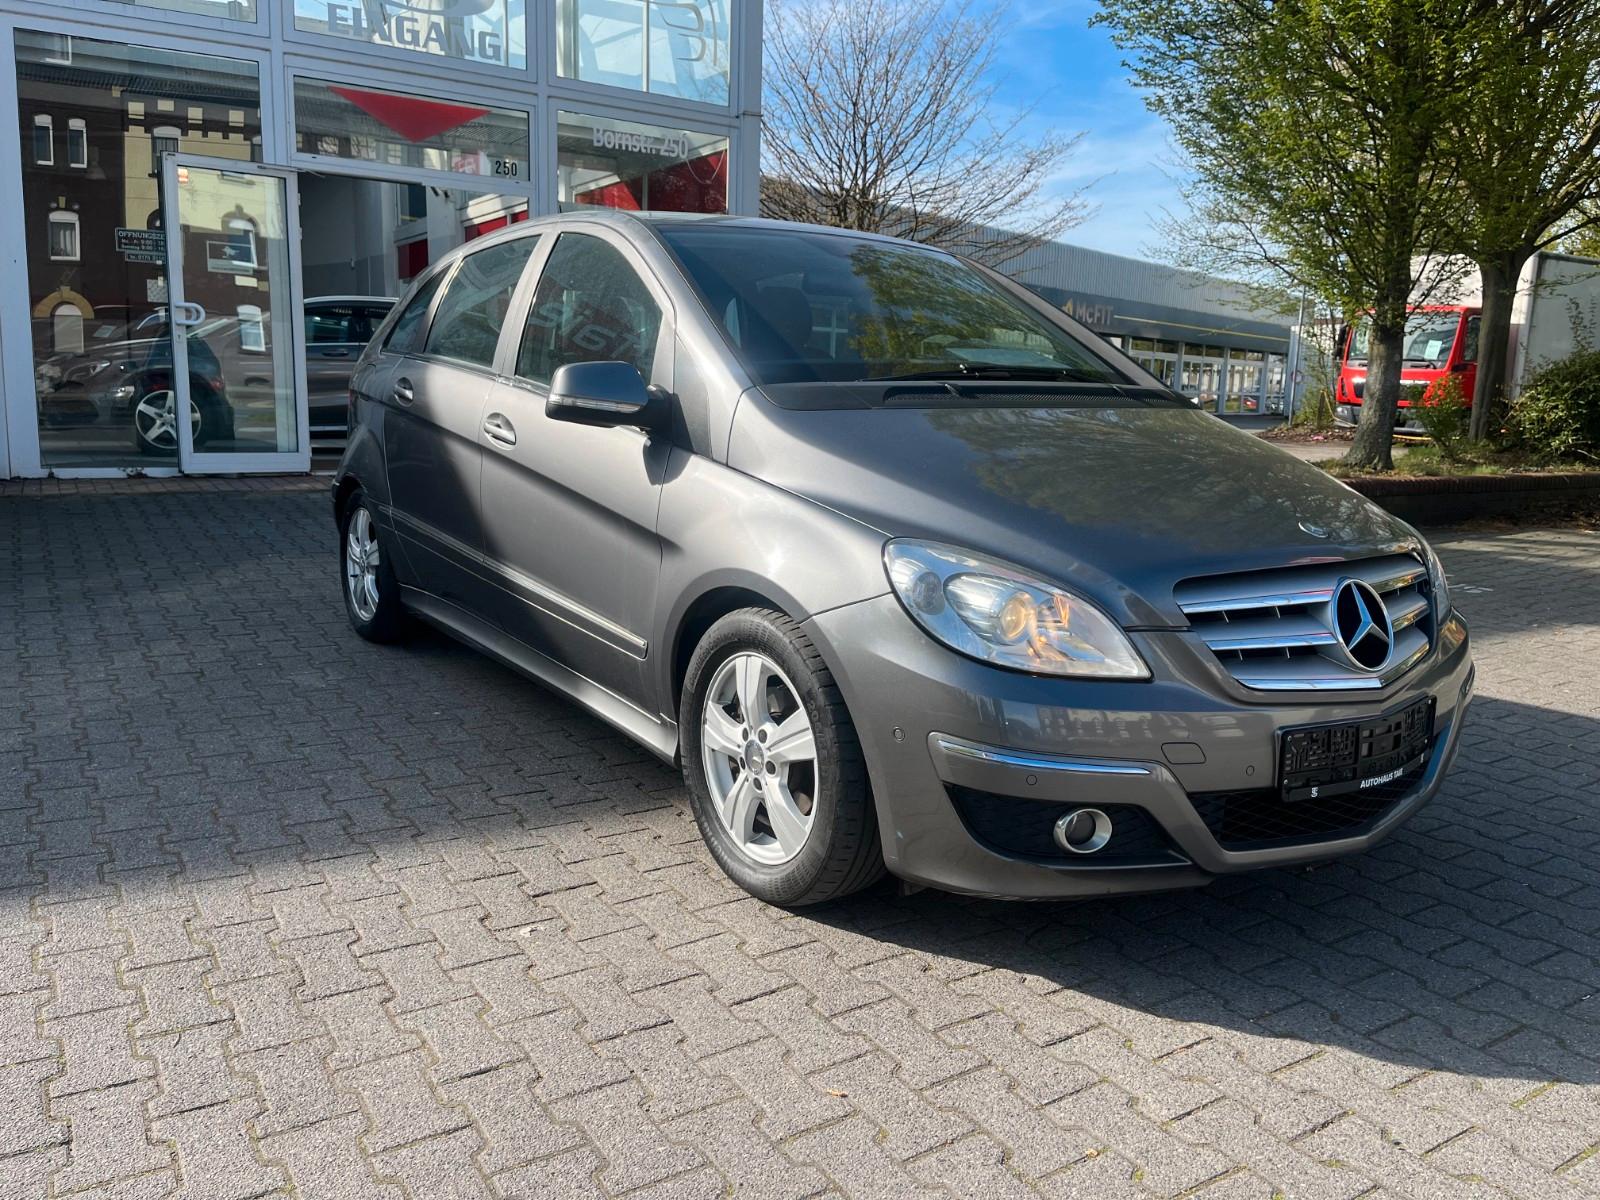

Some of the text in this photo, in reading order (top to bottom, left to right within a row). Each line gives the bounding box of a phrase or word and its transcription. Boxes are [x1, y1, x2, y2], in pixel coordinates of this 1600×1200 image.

[327, 2, 502, 62] EINGANG
[593, 127, 689, 159] Bornstr. 250
[495, 160, 518, 177] 250
[1076, 302, 1114, 325] McFIT
[1359, 772, 1393, 788] AUTOHAUS
